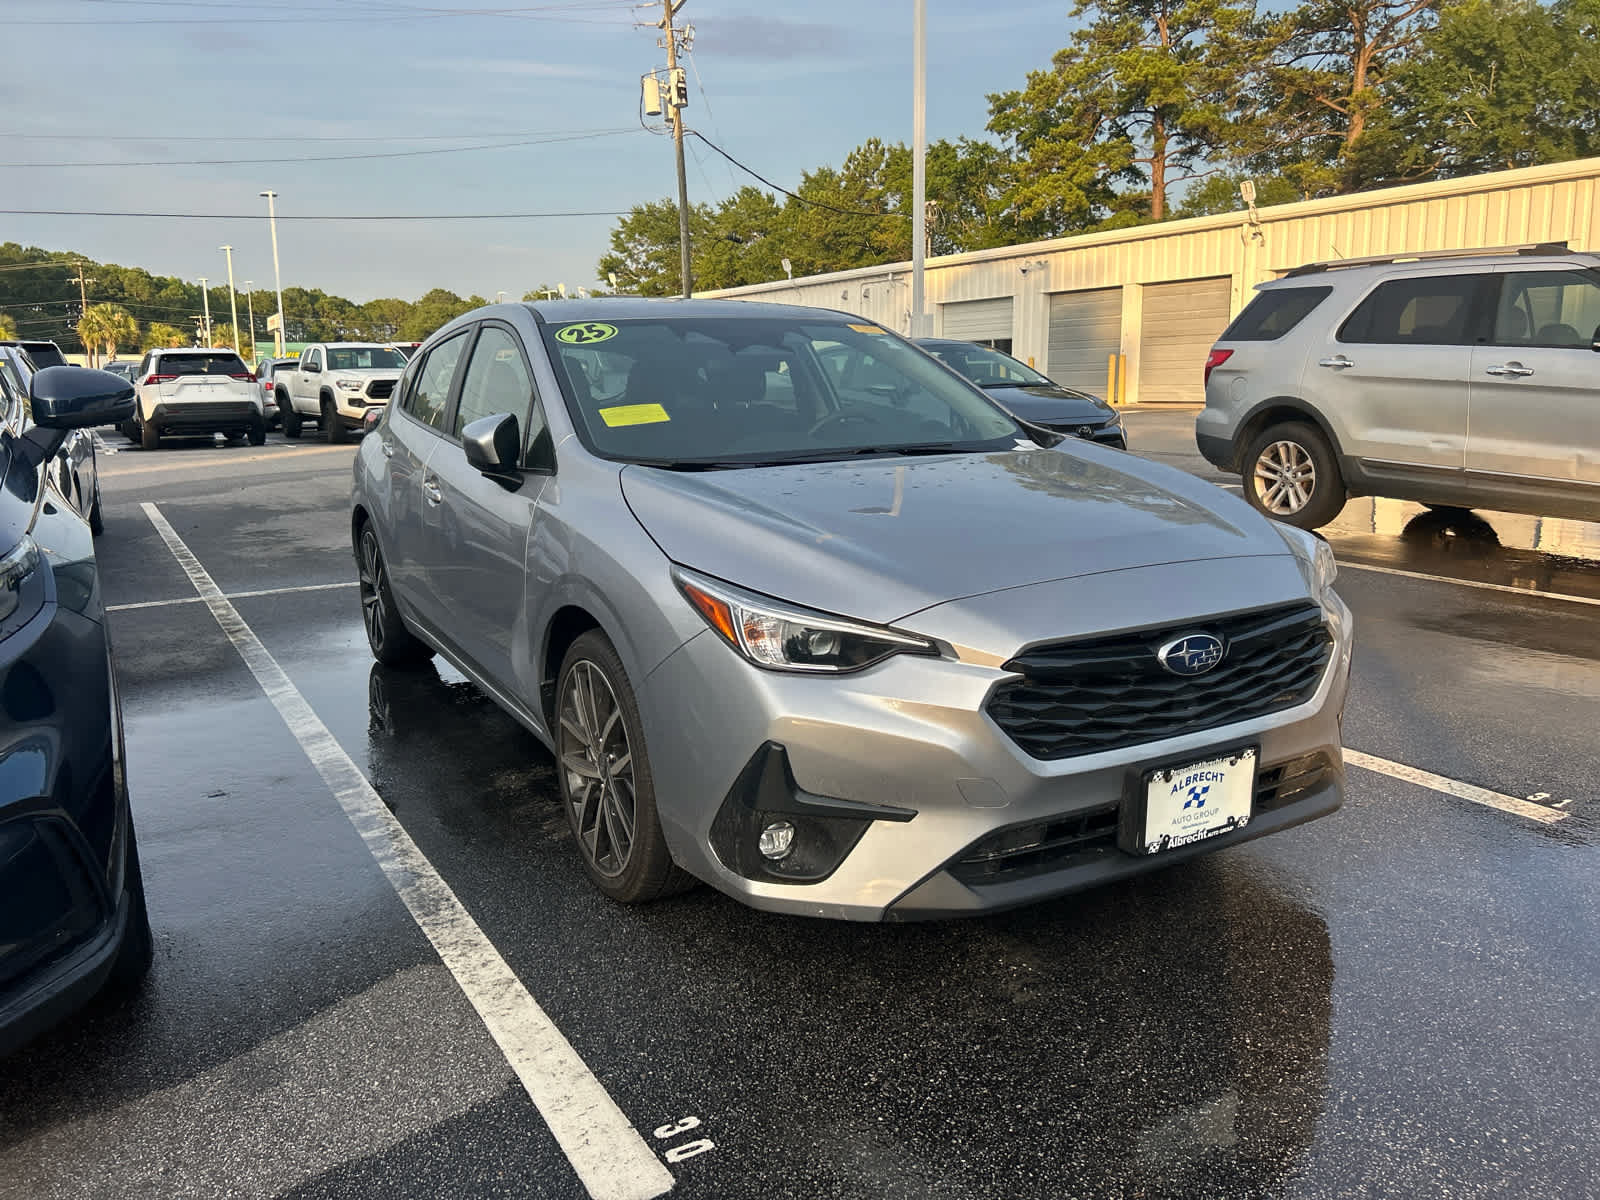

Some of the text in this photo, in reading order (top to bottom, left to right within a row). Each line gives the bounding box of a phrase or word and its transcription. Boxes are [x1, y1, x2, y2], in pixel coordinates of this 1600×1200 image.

[567, 324, 606, 343] 25
[1171, 771, 1225, 795] ALBRECHT
[1172, 813, 1191, 825] AUTO
[1194, 808, 1220, 820] GROUP
[1168, 829, 1208, 849] Albrecht
